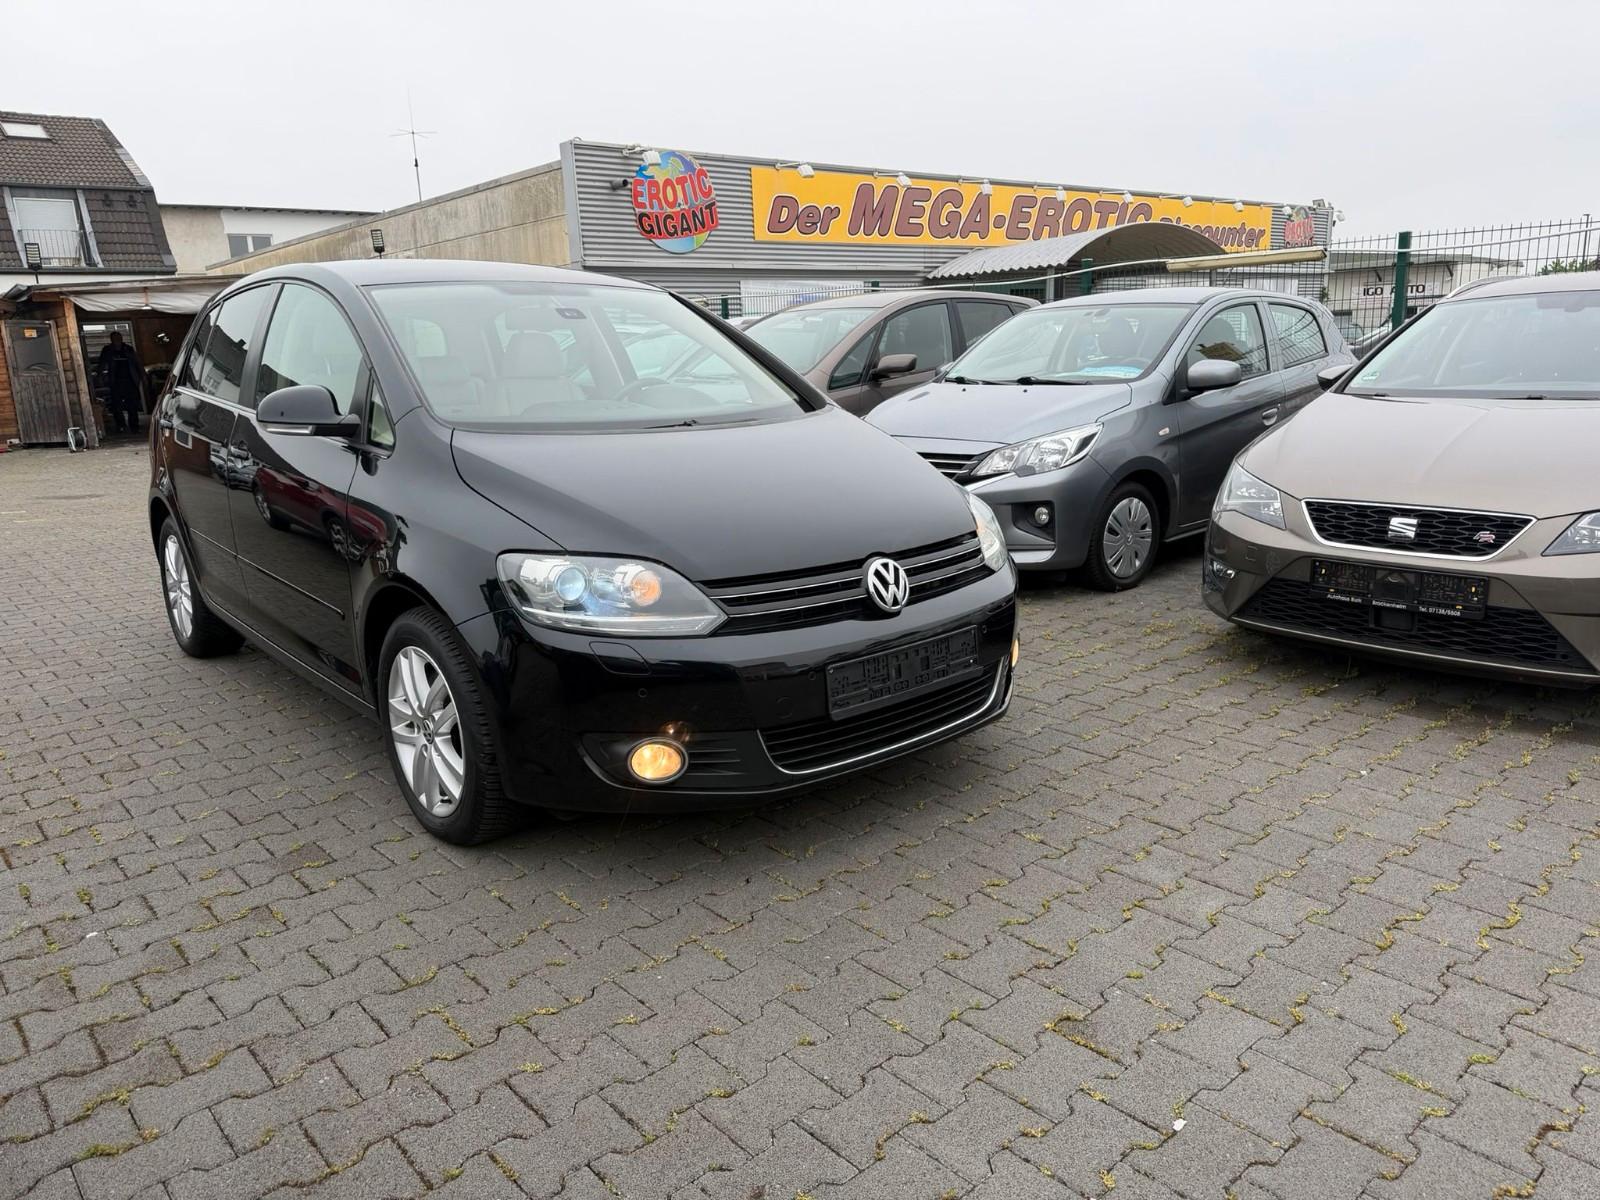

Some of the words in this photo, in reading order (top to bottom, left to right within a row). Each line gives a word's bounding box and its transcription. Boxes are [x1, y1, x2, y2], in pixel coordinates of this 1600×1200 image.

[632, 166, 714, 210] EROTIC
[636, 200, 718, 238] GIGANT
[767, 195, 841, 236] Der
[1160, 216, 1266, 248] ounter
[1390, 284, 1426, 296] ATO
